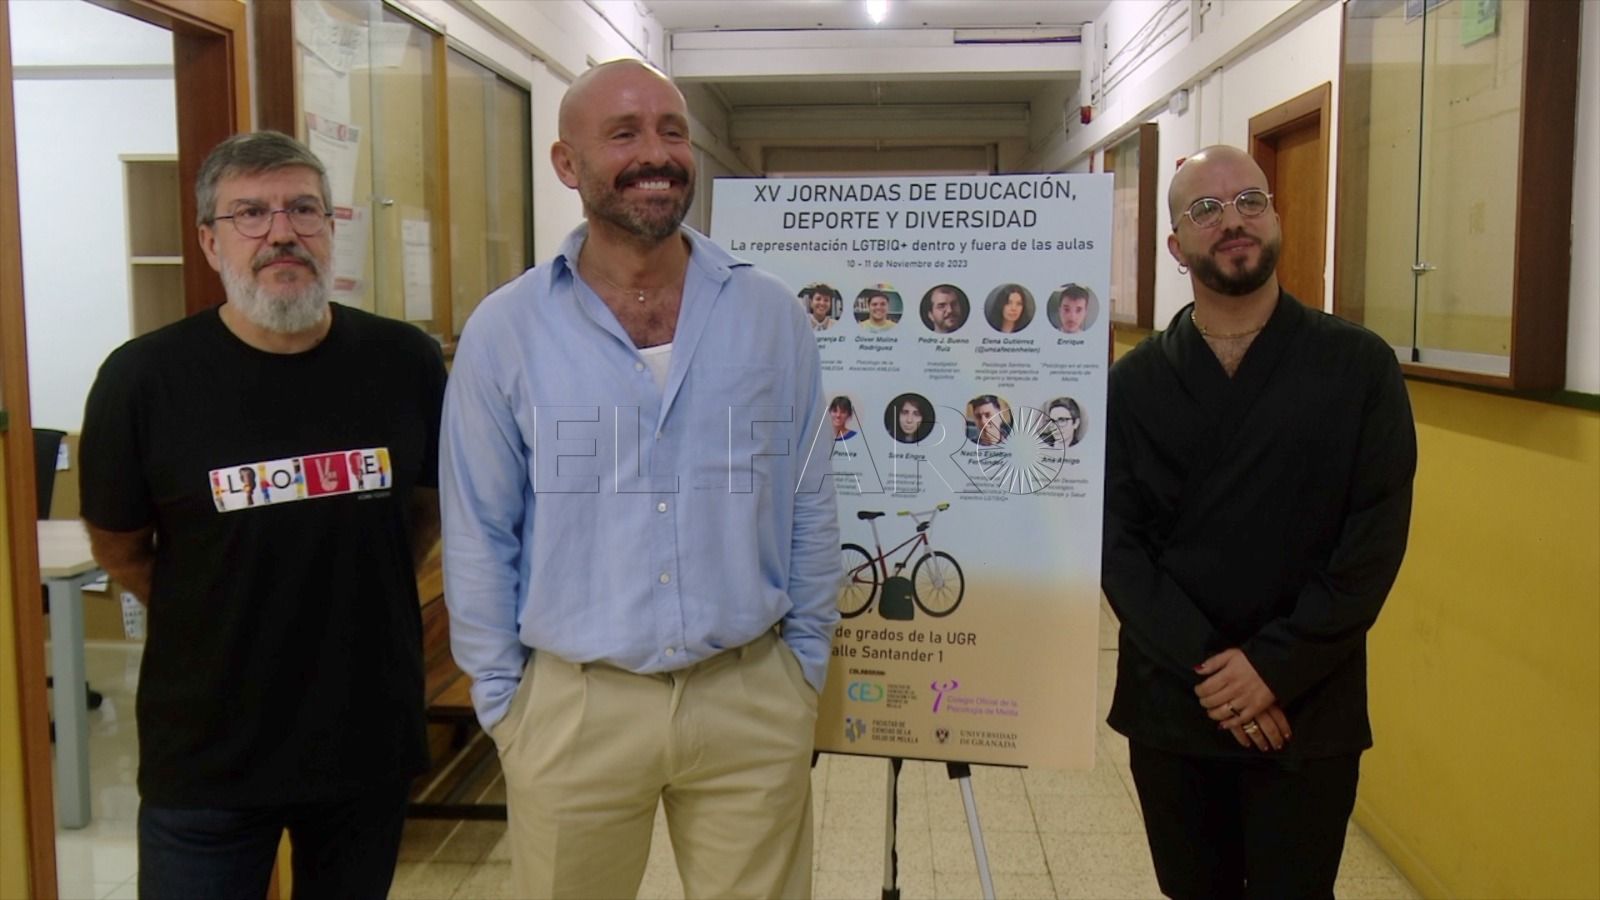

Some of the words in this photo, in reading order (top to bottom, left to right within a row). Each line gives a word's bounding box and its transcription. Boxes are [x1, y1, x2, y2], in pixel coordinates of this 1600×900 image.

[753, 184, 781, 202] XV
[786, 183, 901, 202] JORNADAS
[910, 183, 937, 201] DE
[945, 176, 1077, 202] EDUCACIÓN,
[782, 211, 879, 229] DEPORTE
[885, 211, 900, 229] Y
[905, 210, 1037, 229] DIVERSIDAD
[731, 239, 747, 251] La
[750, 238, 848, 254] representación
[852, 239, 907, 252] LGTBIQ+
[911, 238, 956, 251] dentro
[959, 242, 968, 254] y
[970, 238, 1006, 251] fuera
[1010, 238, 1027, 251] de
[1031, 238, 1052, 251] las
[1056, 237, 1094, 250] aulas
[846, 260, 856, 268] 10
[873, 260, 884, 268] de
[886, 259, 933, 268] Noviembre
[934, 259, 946, 268] de
[947, 259, 968, 268] 2023
[835, 625, 852, 639] de
[856, 627, 904, 643] grados
[908, 628, 925, 643] de
[930, 630, 942, 645] la
[947, 632, 976, 646] UGR
[831, 644, 857, 658] alle
[861, 646, 934, 663] Santander
[938, 651, 944, 663] 1
